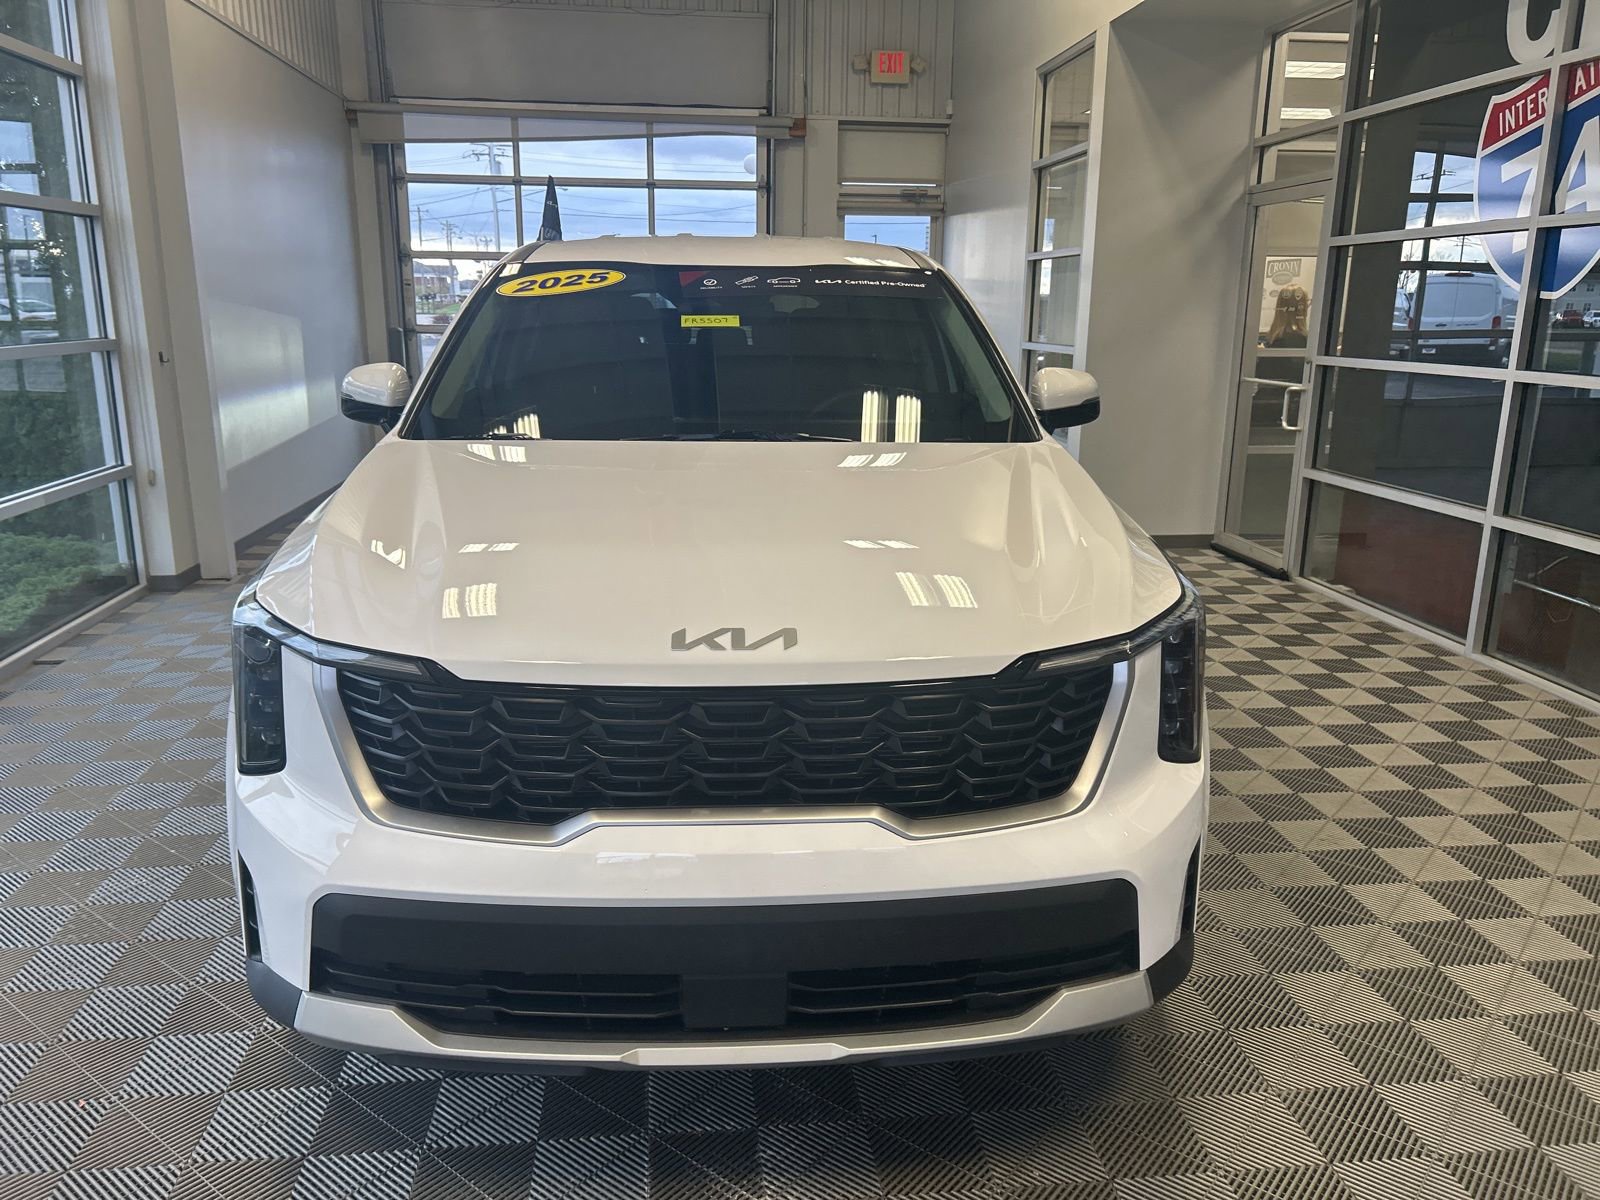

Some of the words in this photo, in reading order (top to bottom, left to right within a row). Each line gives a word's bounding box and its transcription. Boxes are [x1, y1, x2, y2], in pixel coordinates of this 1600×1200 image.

[879, 51, 905, 73] EXIT
[511, 272, 612, 292] 2025
[880, 280, 926, 288] Pre-Owned
[671, 627, 798, 651] KIA
